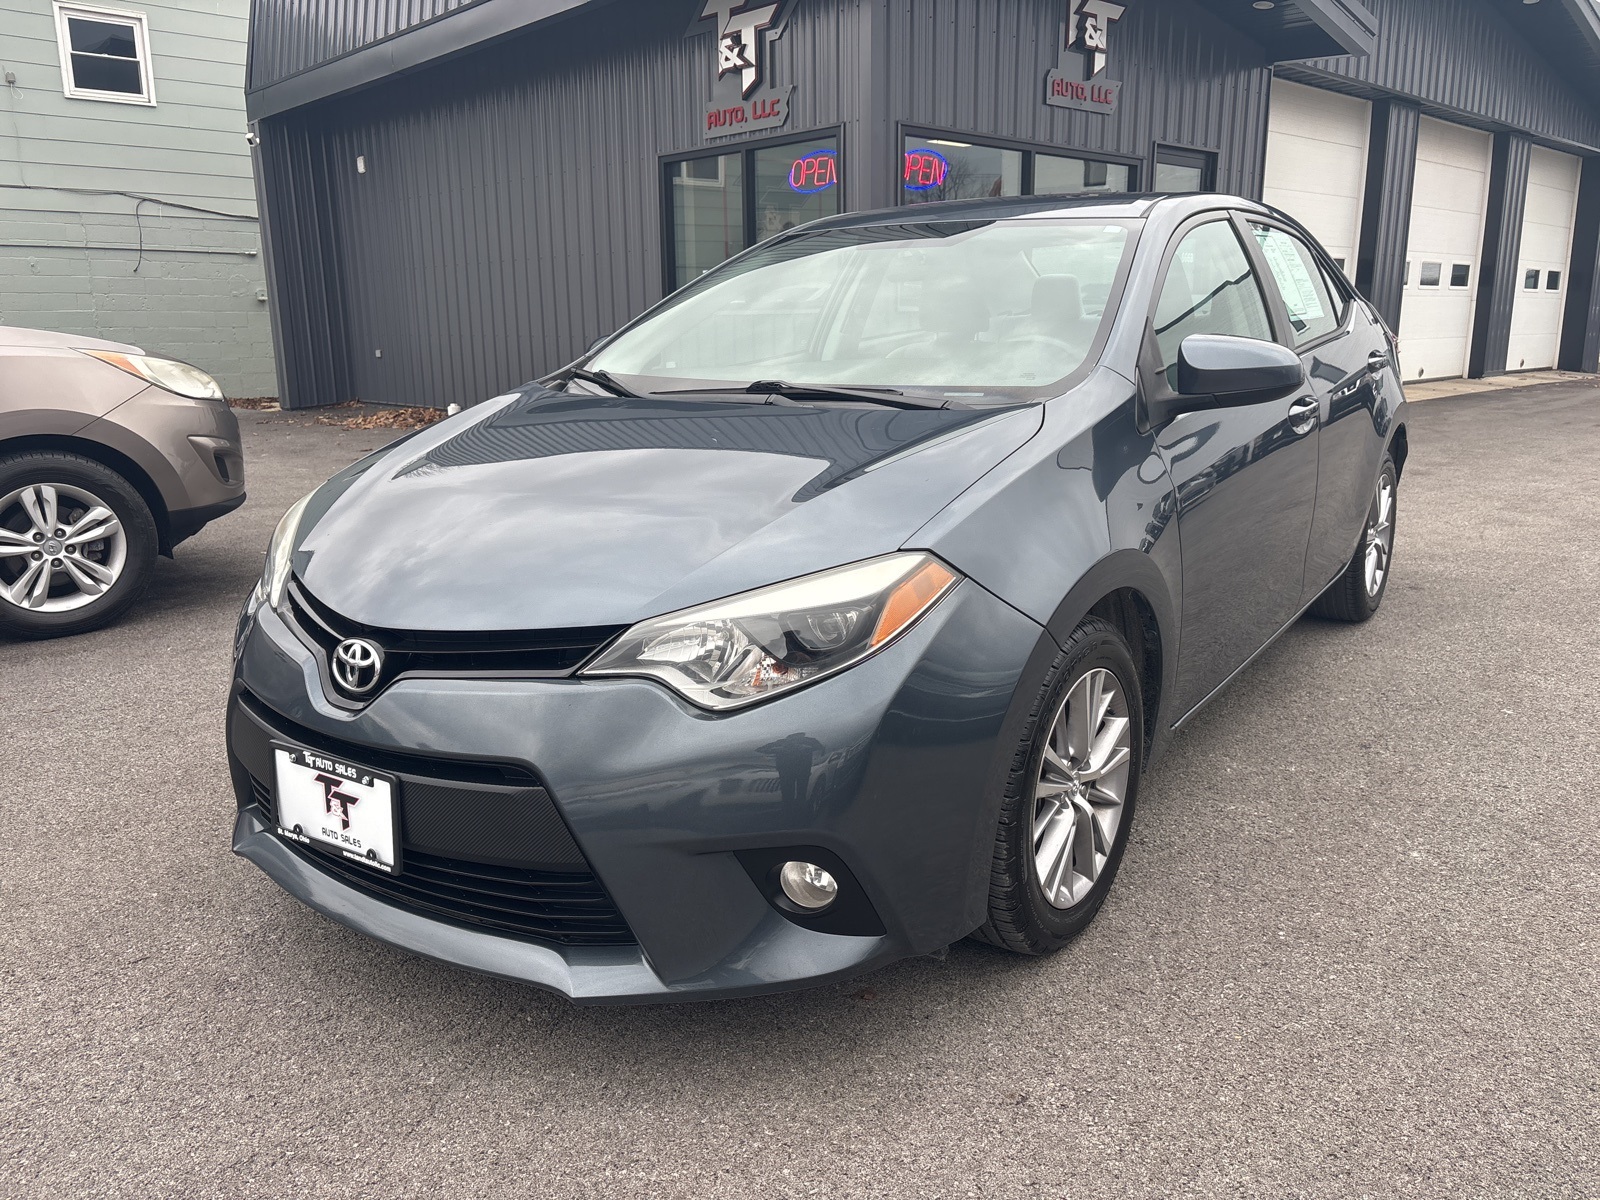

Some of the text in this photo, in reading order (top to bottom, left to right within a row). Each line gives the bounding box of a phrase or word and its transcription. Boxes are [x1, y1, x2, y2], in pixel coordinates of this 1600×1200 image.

[1052, 78, 1113, 104] AUTO, LLC
[707, 98, 780, 130] AUTO, LLC
[315, 757, 333, 771] AUTO
[335, 762, 357, 778] SALES
[314, 773, 360, 831] T&T
[321, 827, 361, 848] AUTO SALES
